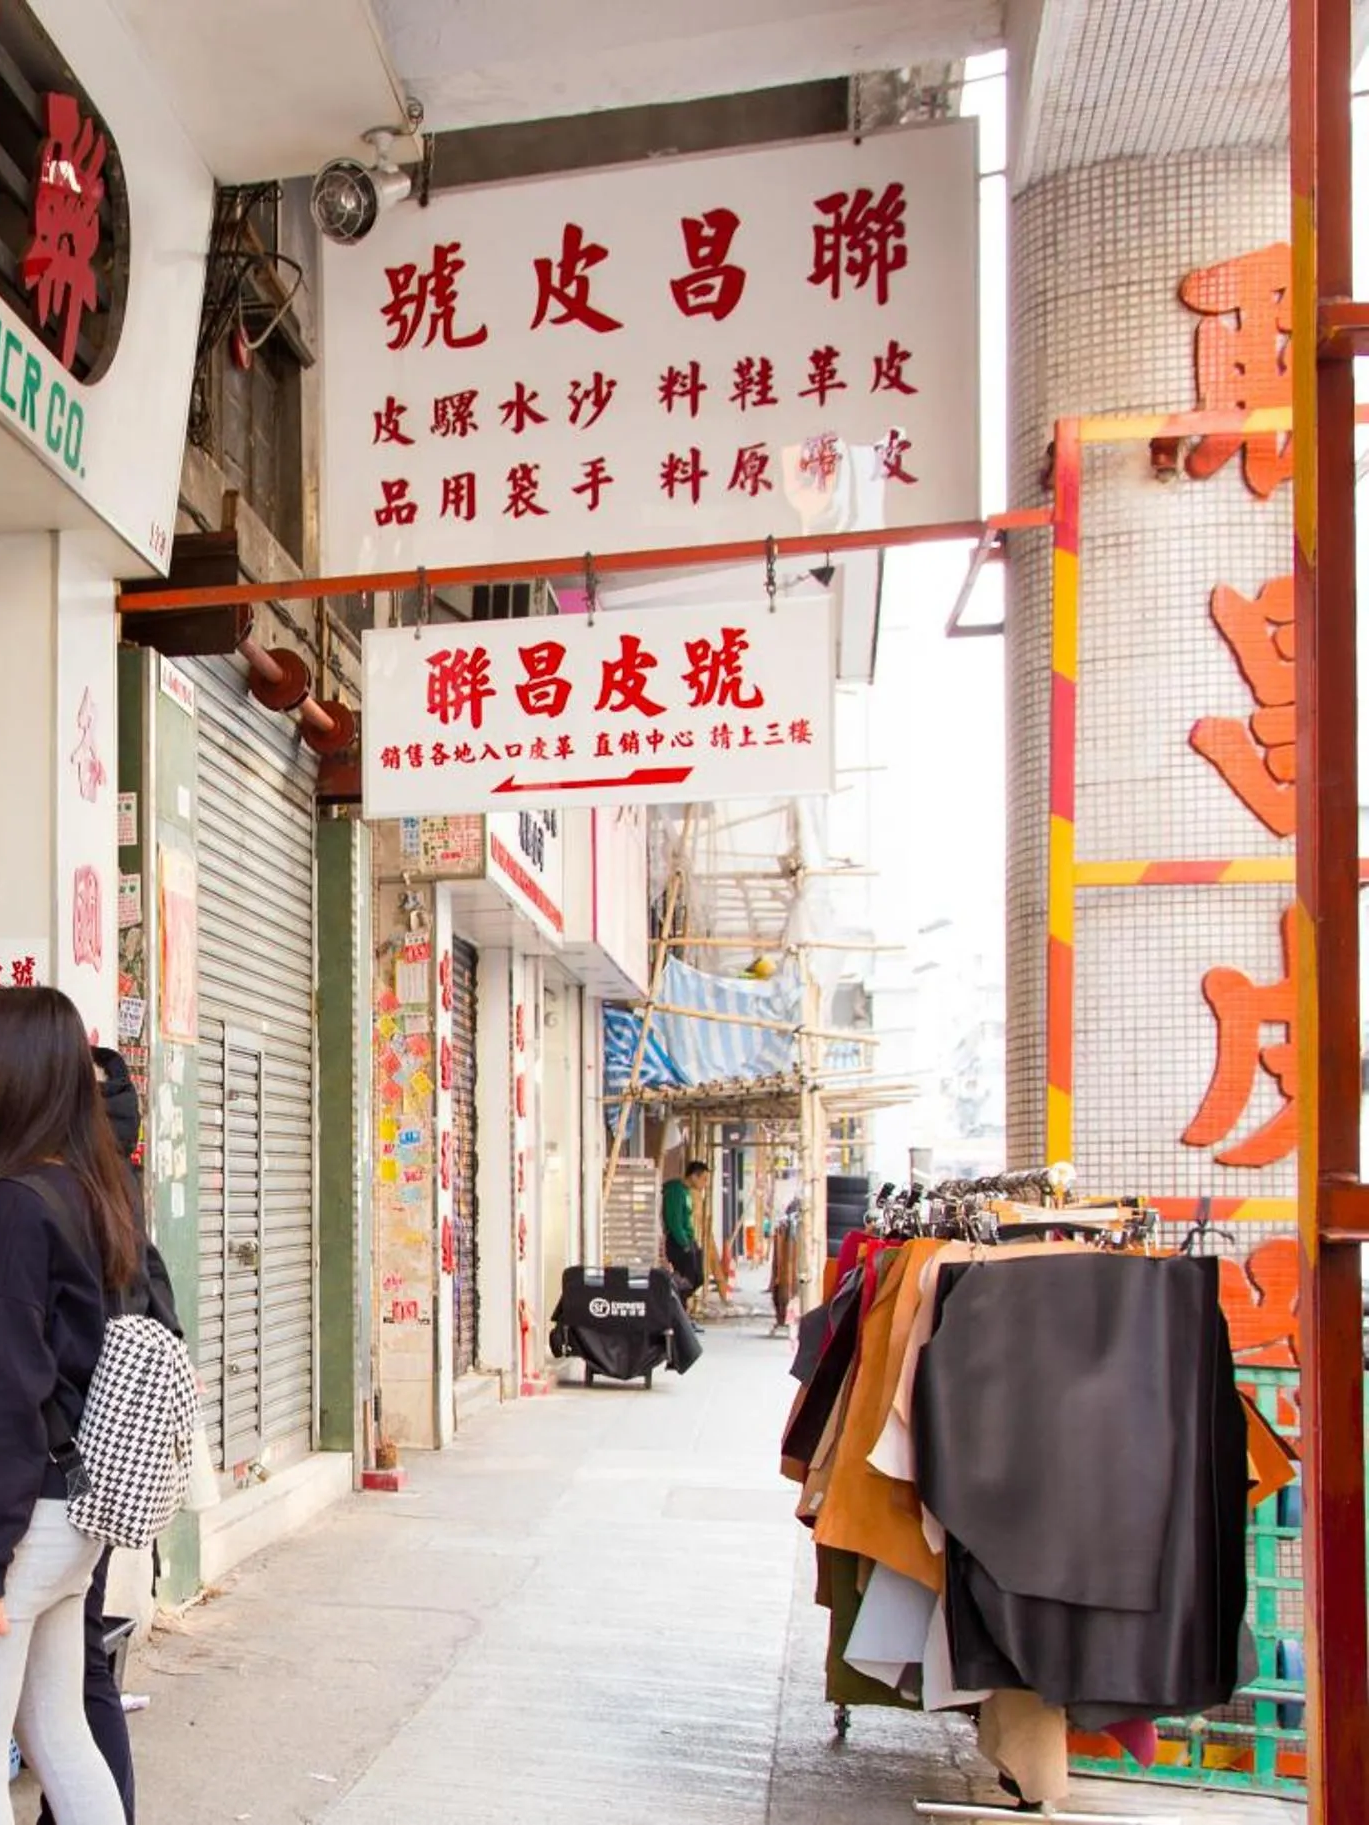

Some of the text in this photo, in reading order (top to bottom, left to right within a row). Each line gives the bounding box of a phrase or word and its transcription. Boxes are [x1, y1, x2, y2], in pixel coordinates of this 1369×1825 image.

[46, 380, 85, 478] CO.
[425, 626, 765, 730] 聯昌皮號
[380, 733, 575, 770] 銷售各地入口皮革
[593, 728, 696, 758] 直銷中心
